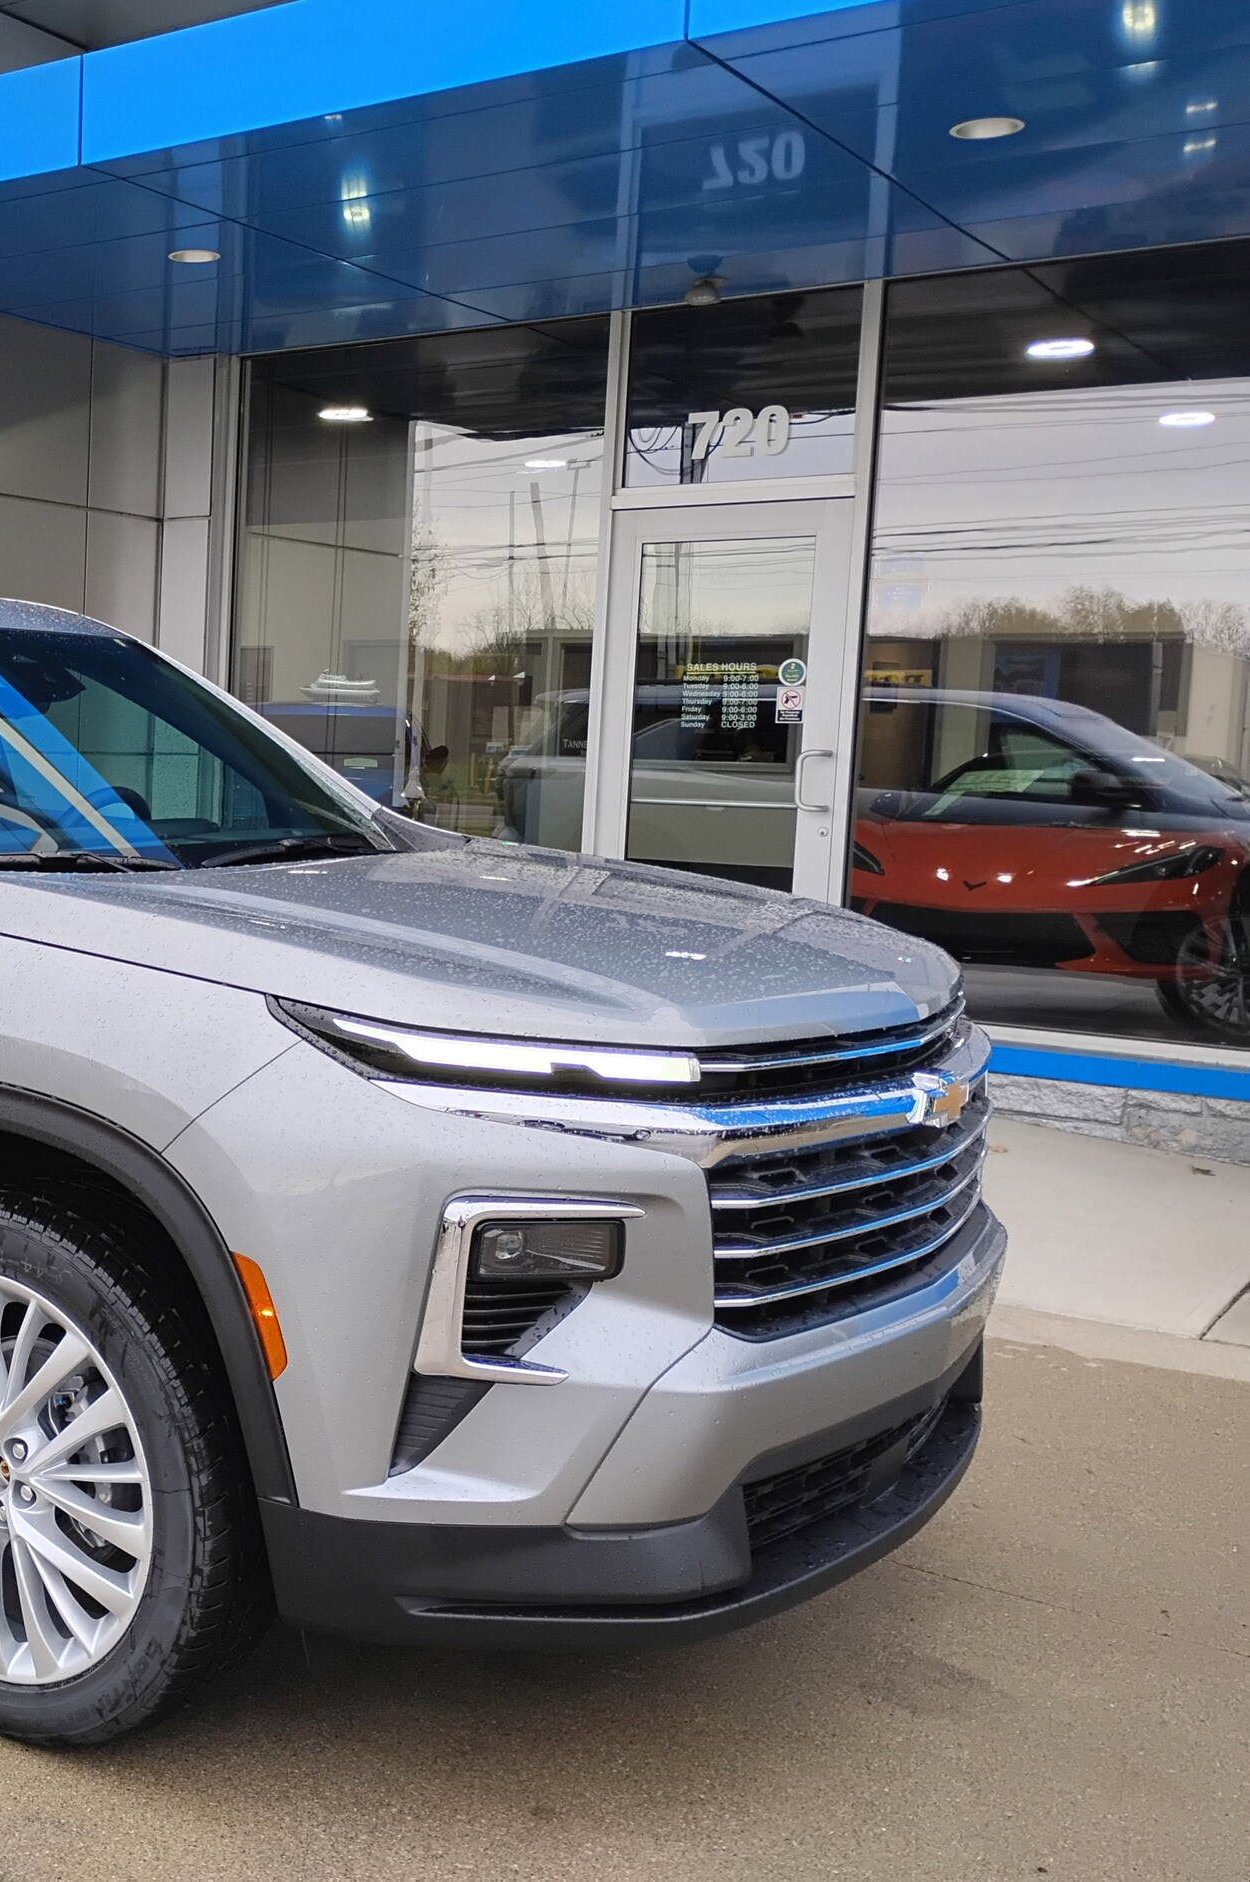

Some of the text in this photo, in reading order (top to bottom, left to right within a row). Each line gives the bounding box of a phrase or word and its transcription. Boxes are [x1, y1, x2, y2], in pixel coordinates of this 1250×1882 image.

[688, 405, 791, 460] 720
[687, 662, 757, 672] SALES HOURS
[682, 675, 710, 683] Monday
[682, 690, 721, 698] Wednesday
[682, 698, 713, 706] Thursday
[681, 713, 710, 721] Saturday
[680, 721, 756, 729] Sunday CLOSED
